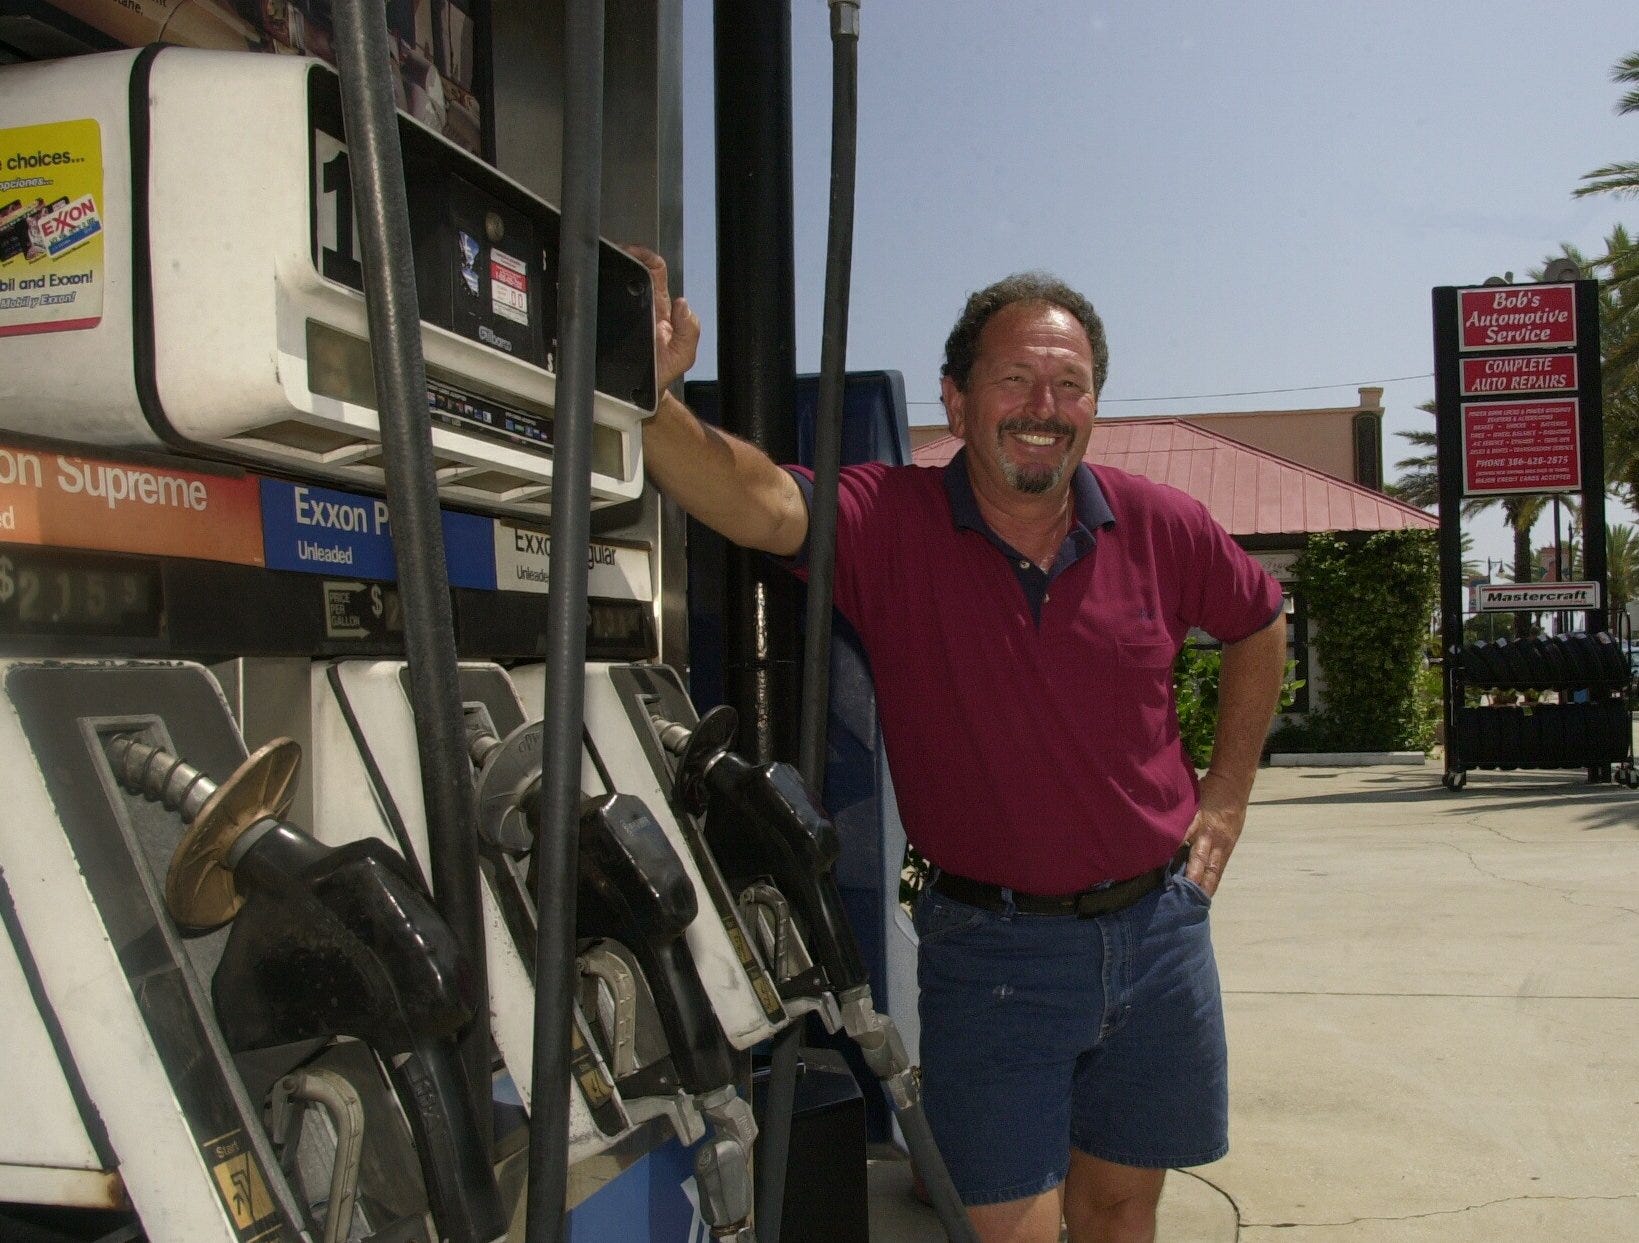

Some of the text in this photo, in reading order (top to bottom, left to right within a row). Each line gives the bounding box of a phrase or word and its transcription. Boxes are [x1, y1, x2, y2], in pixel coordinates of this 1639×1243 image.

[7, 150, 85, 170] choices...
[41, 198, 95, 237] EXXON
[19, 274, 46, 290] and
[49, 269, 94, 287] Exxon!
[1493, 291, 1541, 309] Bob's
[1466, 308, 1569, 327] Automotive
[1485, 325, 1551, 343] Service
[1485, 358, 1553, 373] COMPLETE
[1472, 374, 1567, 391] AUTO REPAIRS
[57, 453, 208, 511] Supreme
[294, 486, 368, 533] Exxon
[298, 540, 353, 565] Unleaded
[1487, 589, 1588, 602] Mastercraft
[331, 603, 345, 615] PER
[331, 615, 360, 628] GALLON
